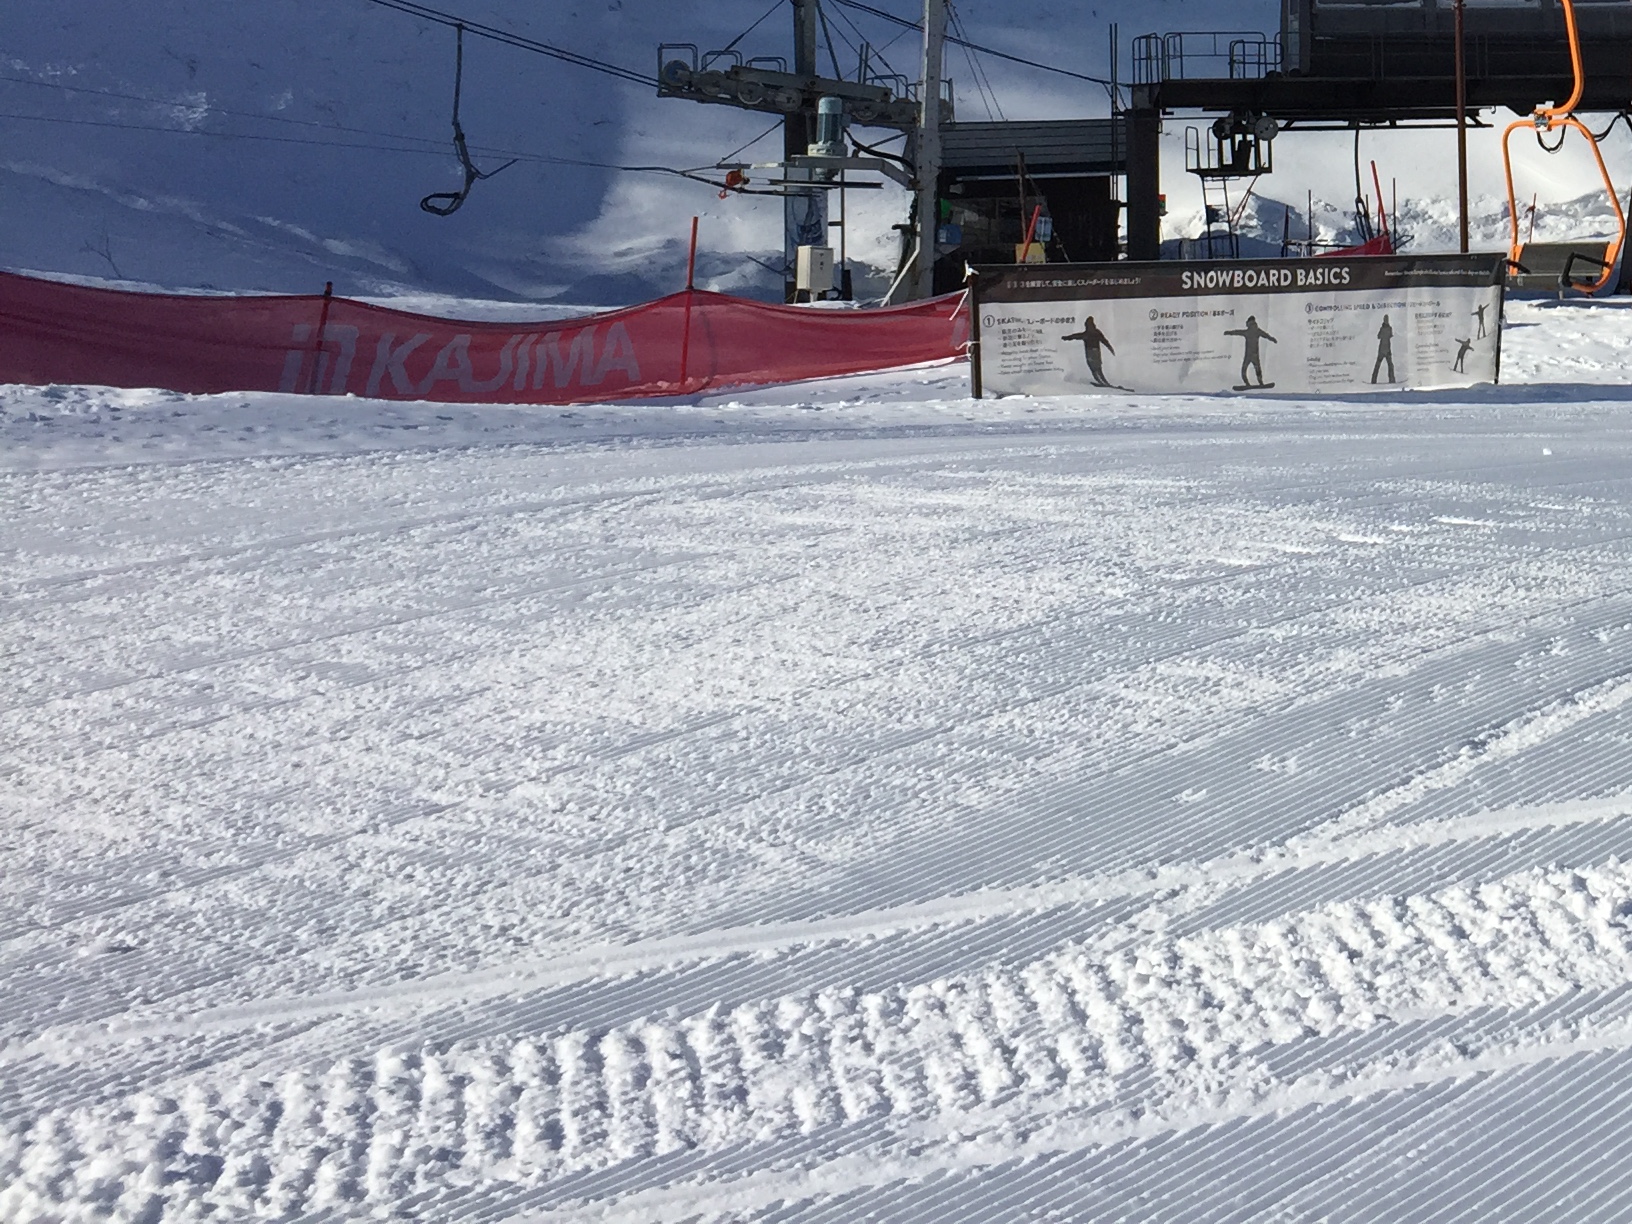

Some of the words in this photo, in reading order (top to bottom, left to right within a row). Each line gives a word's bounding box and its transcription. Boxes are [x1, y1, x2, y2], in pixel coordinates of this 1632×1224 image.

[1181, 269, 1292, 289] SNOWBOARD
[1296, 267, 1351, 285] BASICS
[366, 321, 642, 397] KAJIMA
